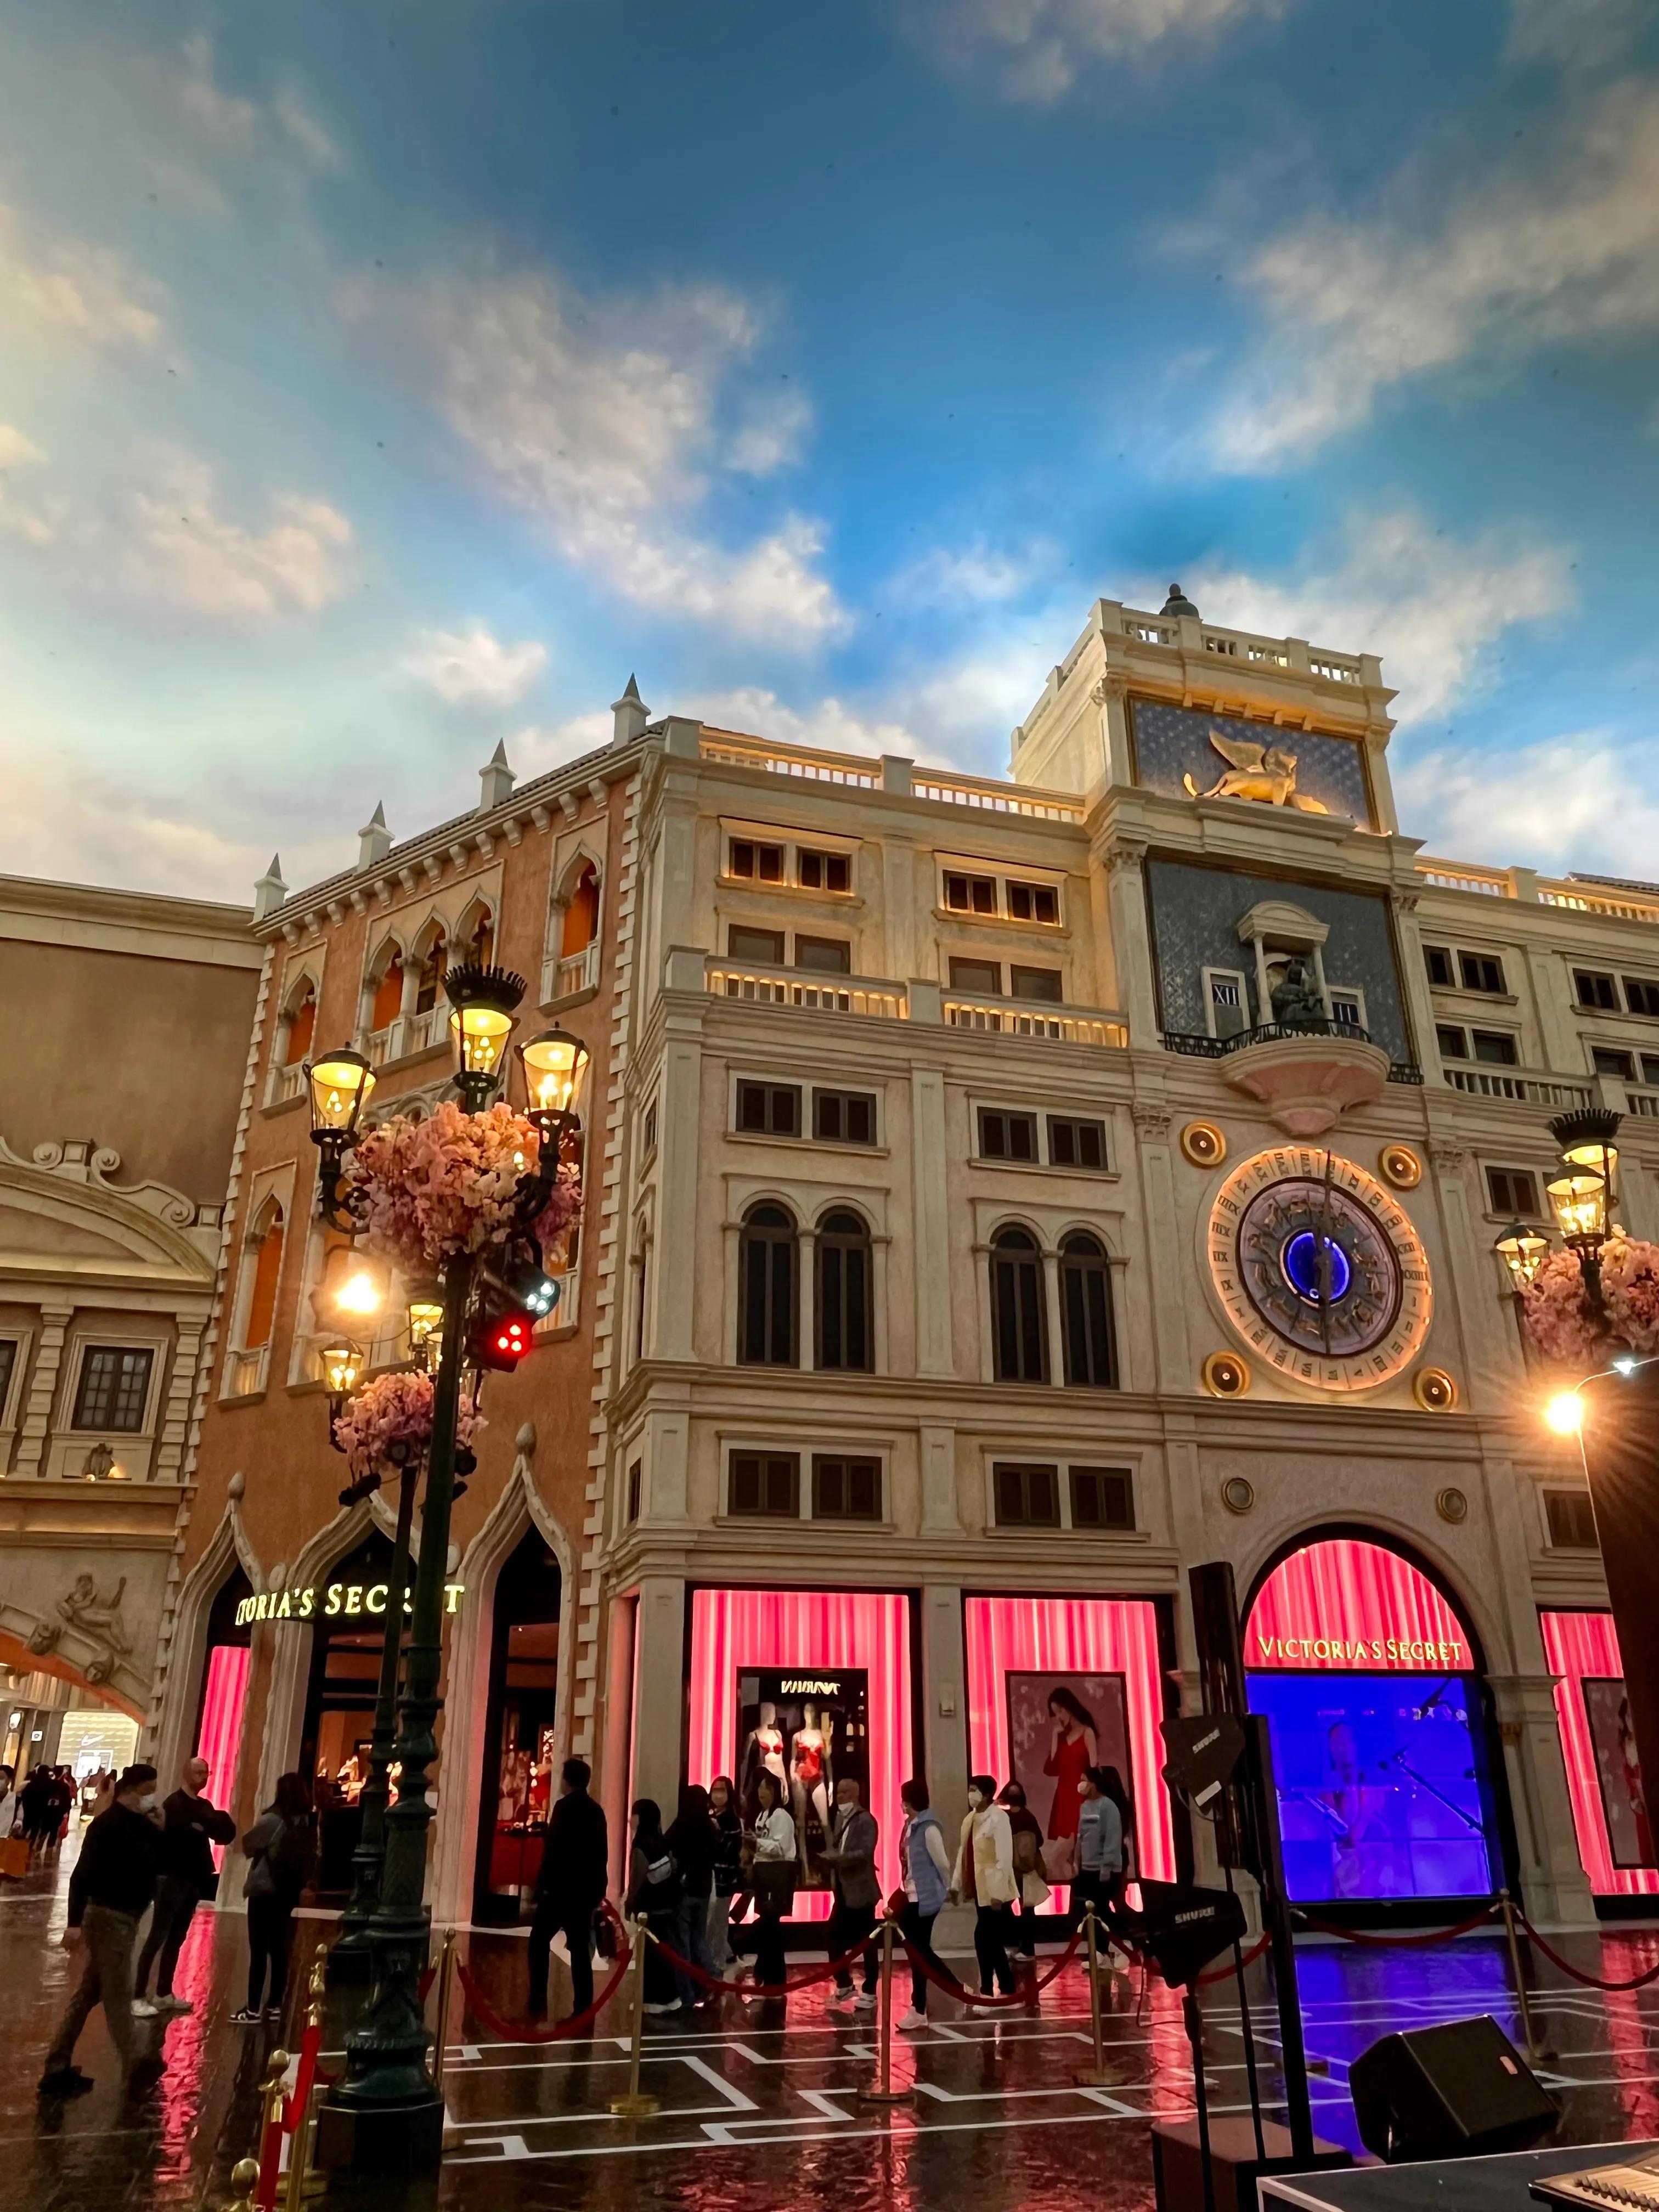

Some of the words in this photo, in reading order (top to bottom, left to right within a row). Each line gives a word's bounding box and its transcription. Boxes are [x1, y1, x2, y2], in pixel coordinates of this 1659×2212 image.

[1214, 984, 1237, 1005] XII
[324, 1583, 465, 1615] SECT
[1257, 1636, 1381, 1660] VICTORIA'S
[1387, 1638, 1462, 1661] SECRET
